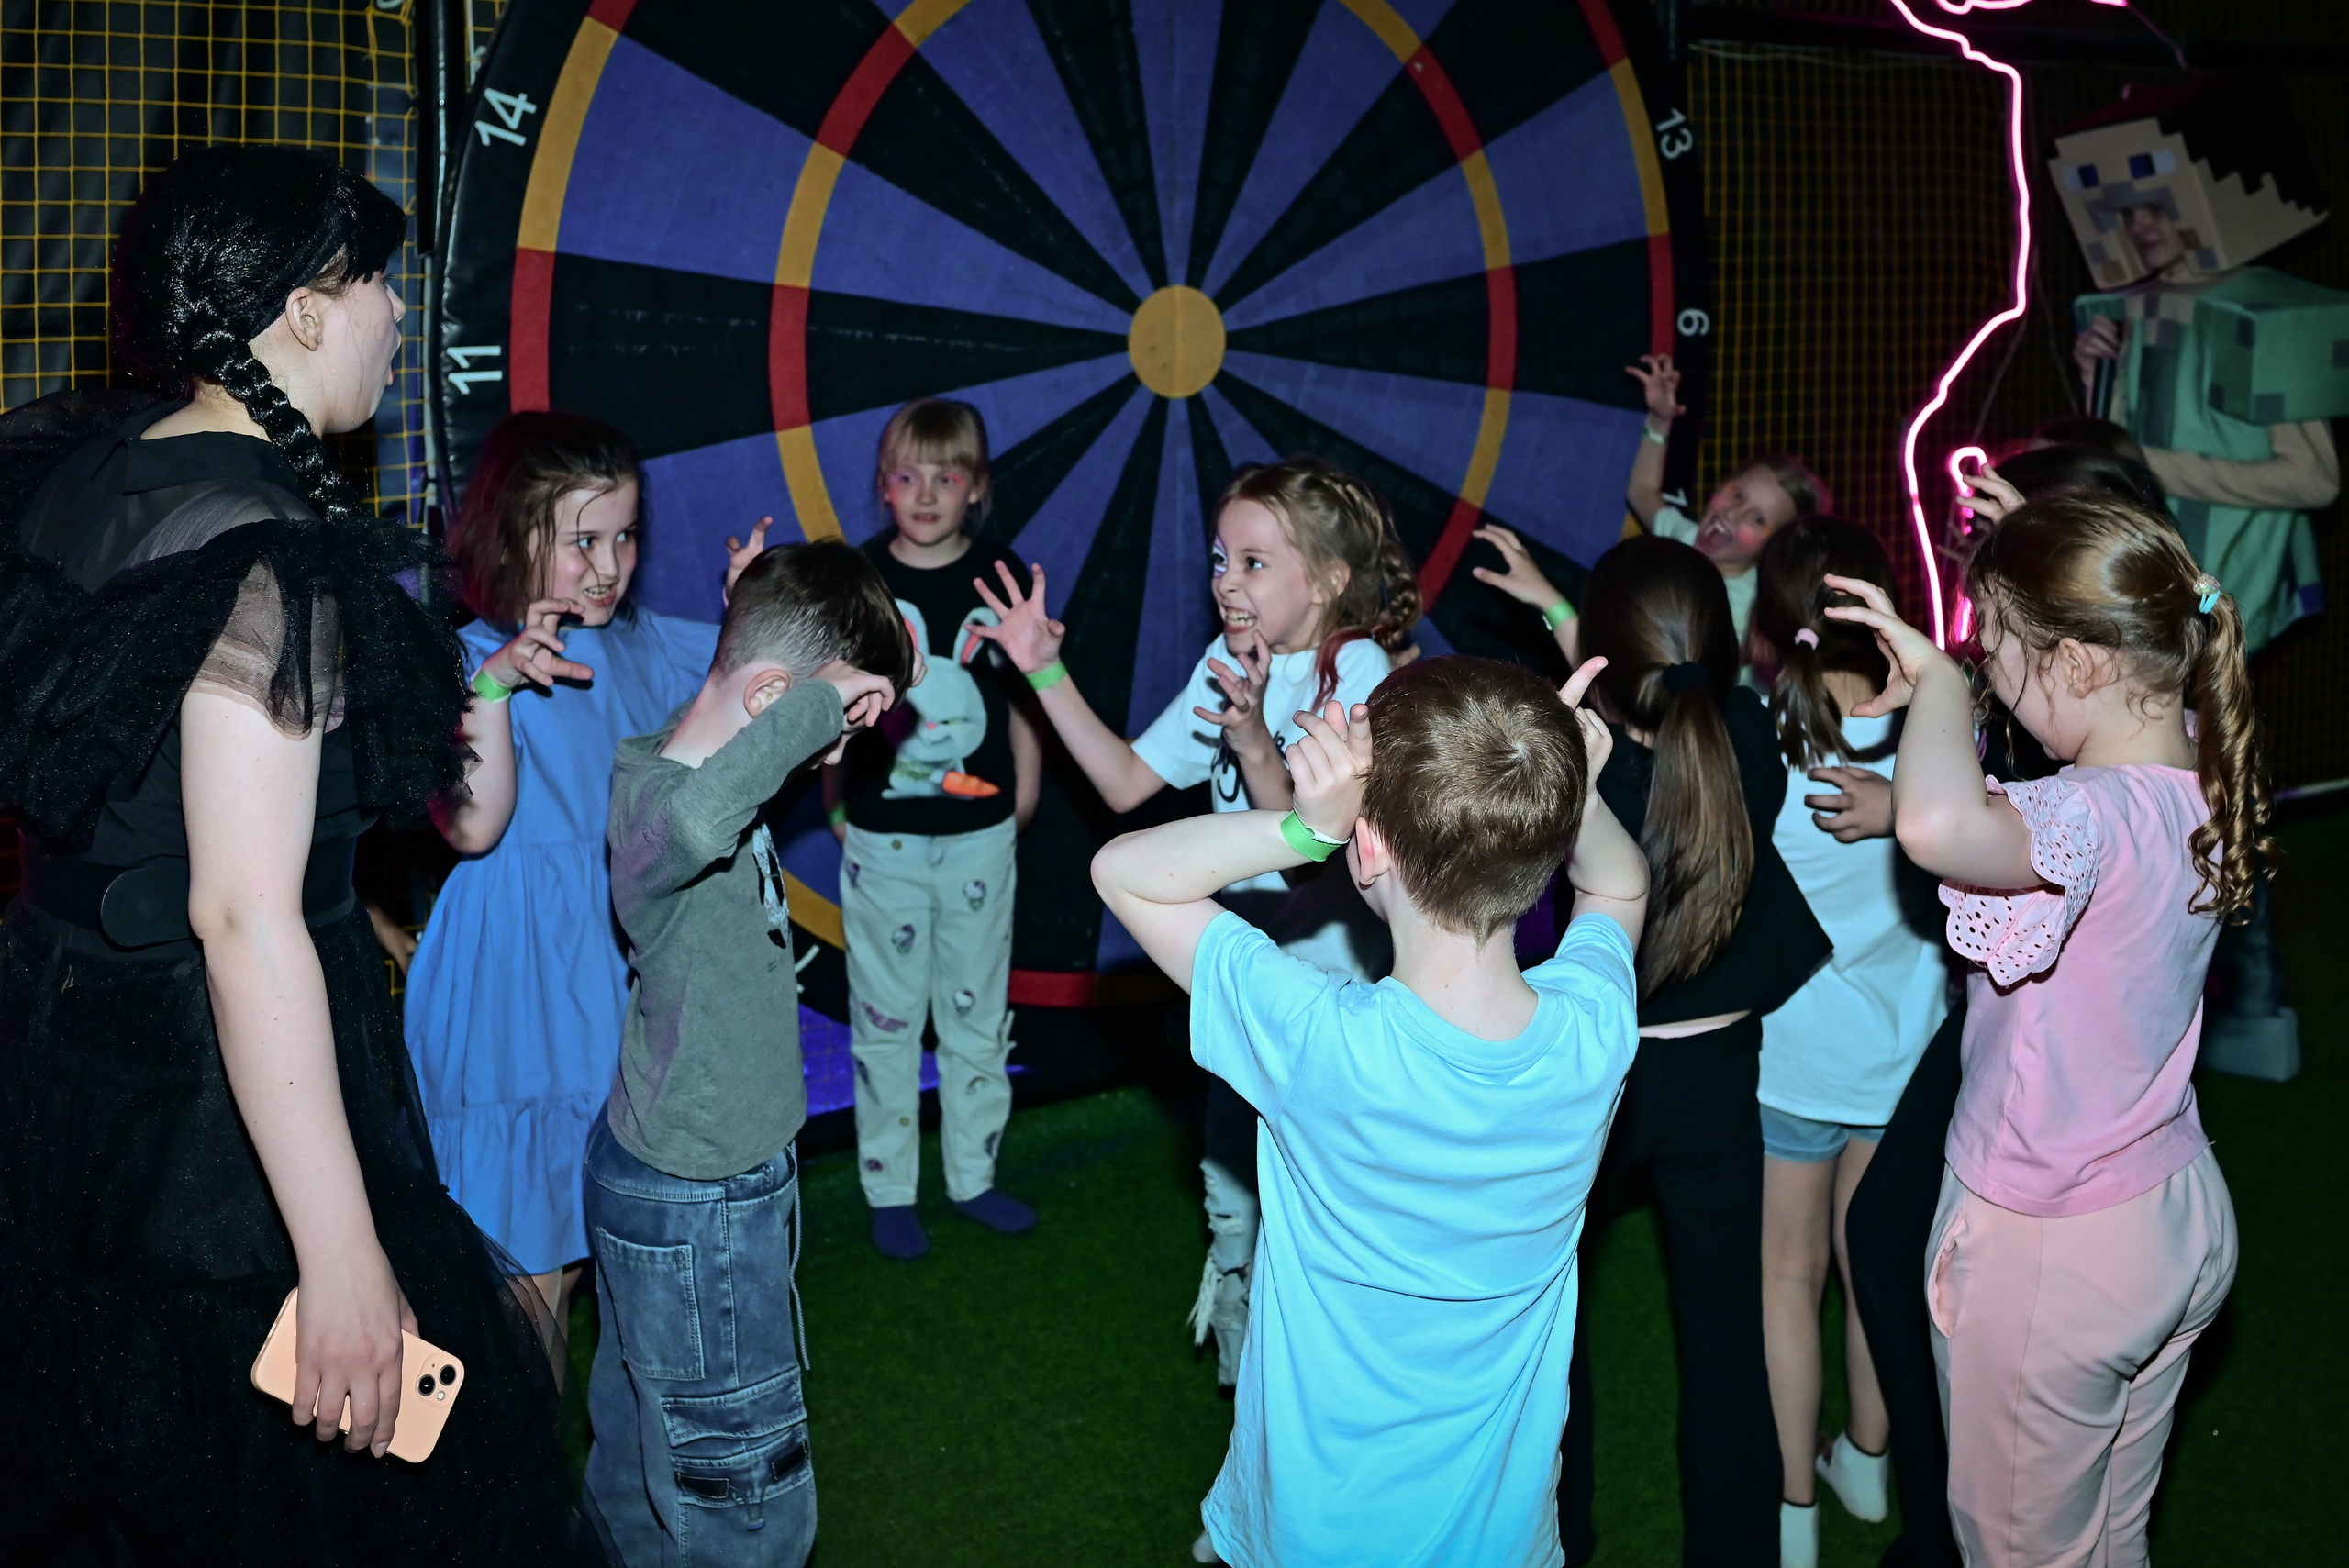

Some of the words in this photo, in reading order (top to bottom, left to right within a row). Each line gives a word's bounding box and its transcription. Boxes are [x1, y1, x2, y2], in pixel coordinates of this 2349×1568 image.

[475, 87, 538, 147] 14
[1655, 107, 1694, 160] 13
[1676, 307, 1710, 337] 6
[446, 345, 503, 395] 11
